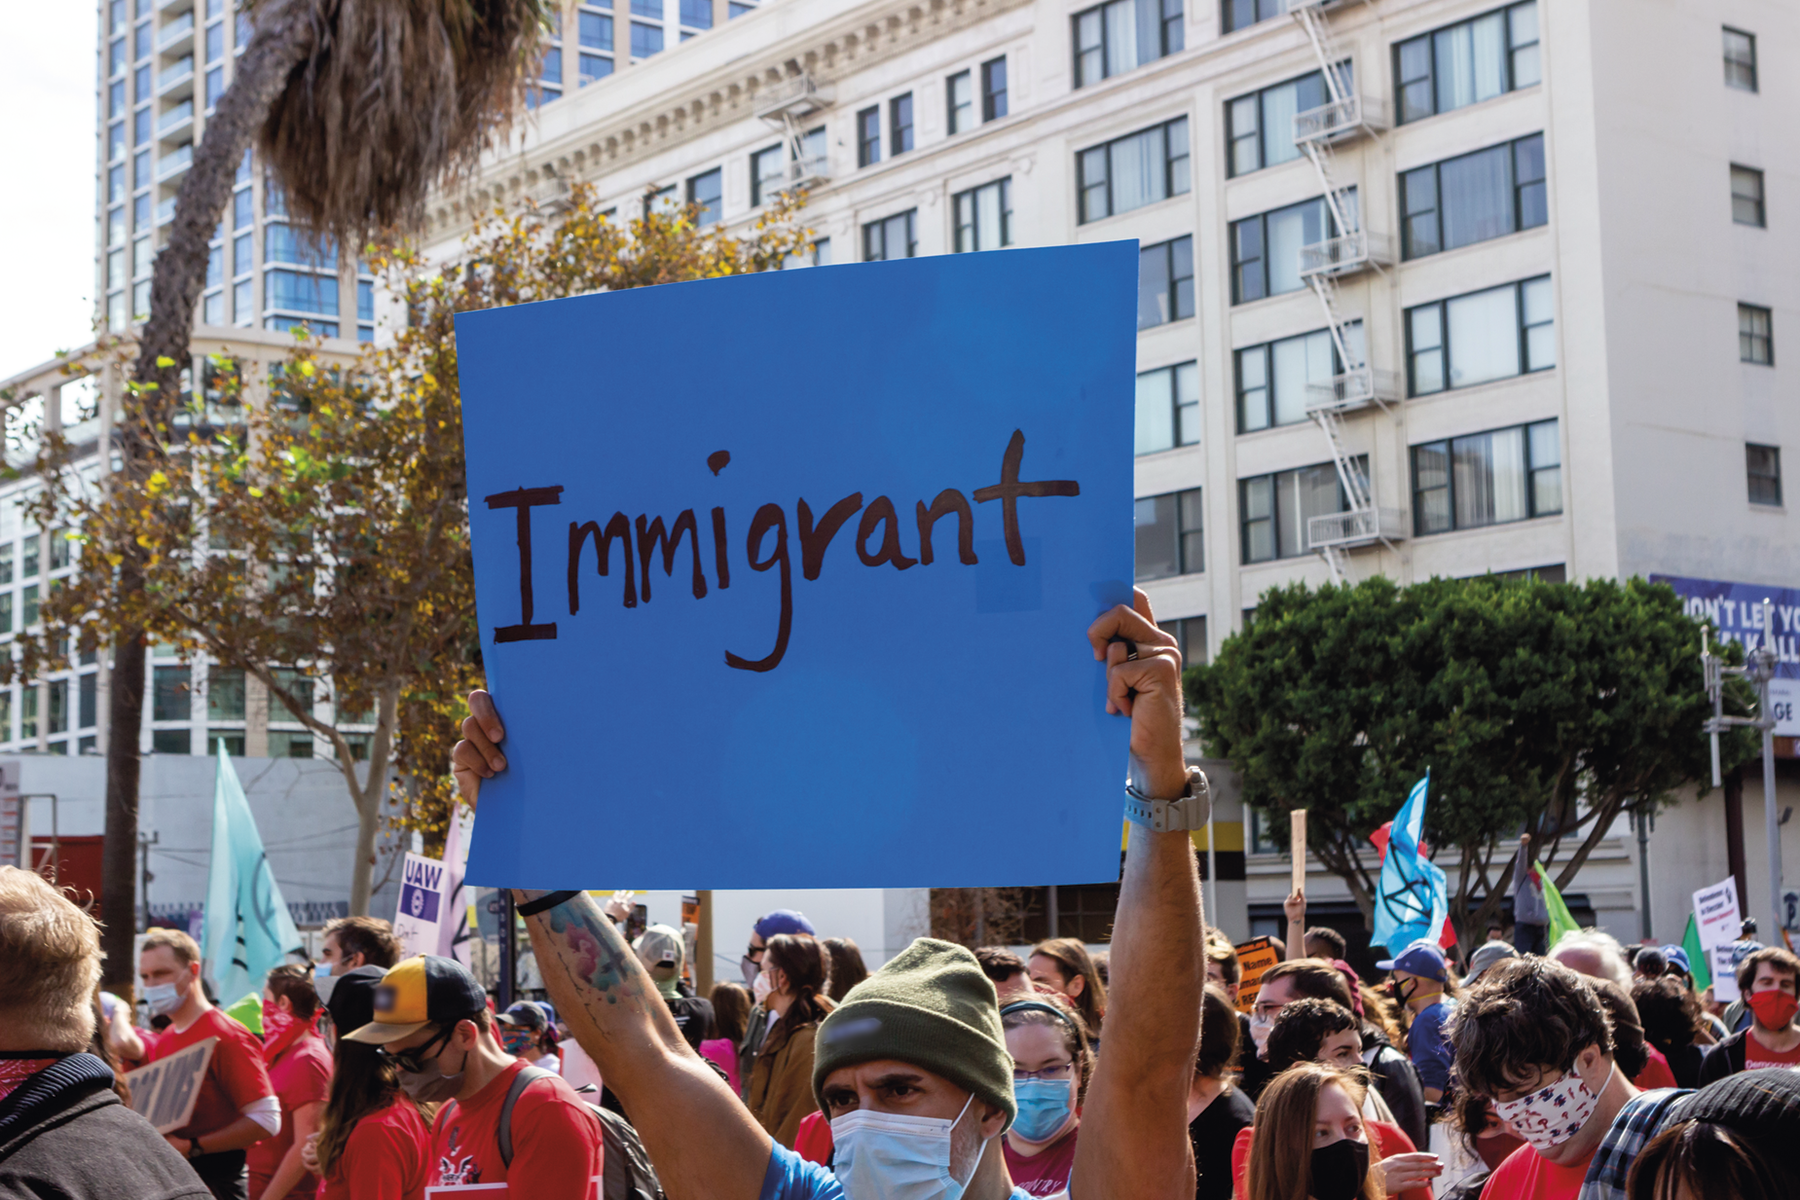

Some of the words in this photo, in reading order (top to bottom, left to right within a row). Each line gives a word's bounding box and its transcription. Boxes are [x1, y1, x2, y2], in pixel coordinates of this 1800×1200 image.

[485, 429, 1081, 671] Immigrant
[405, 859, 443, 890] UAW
[1243, 957, 1273, 971] Name
